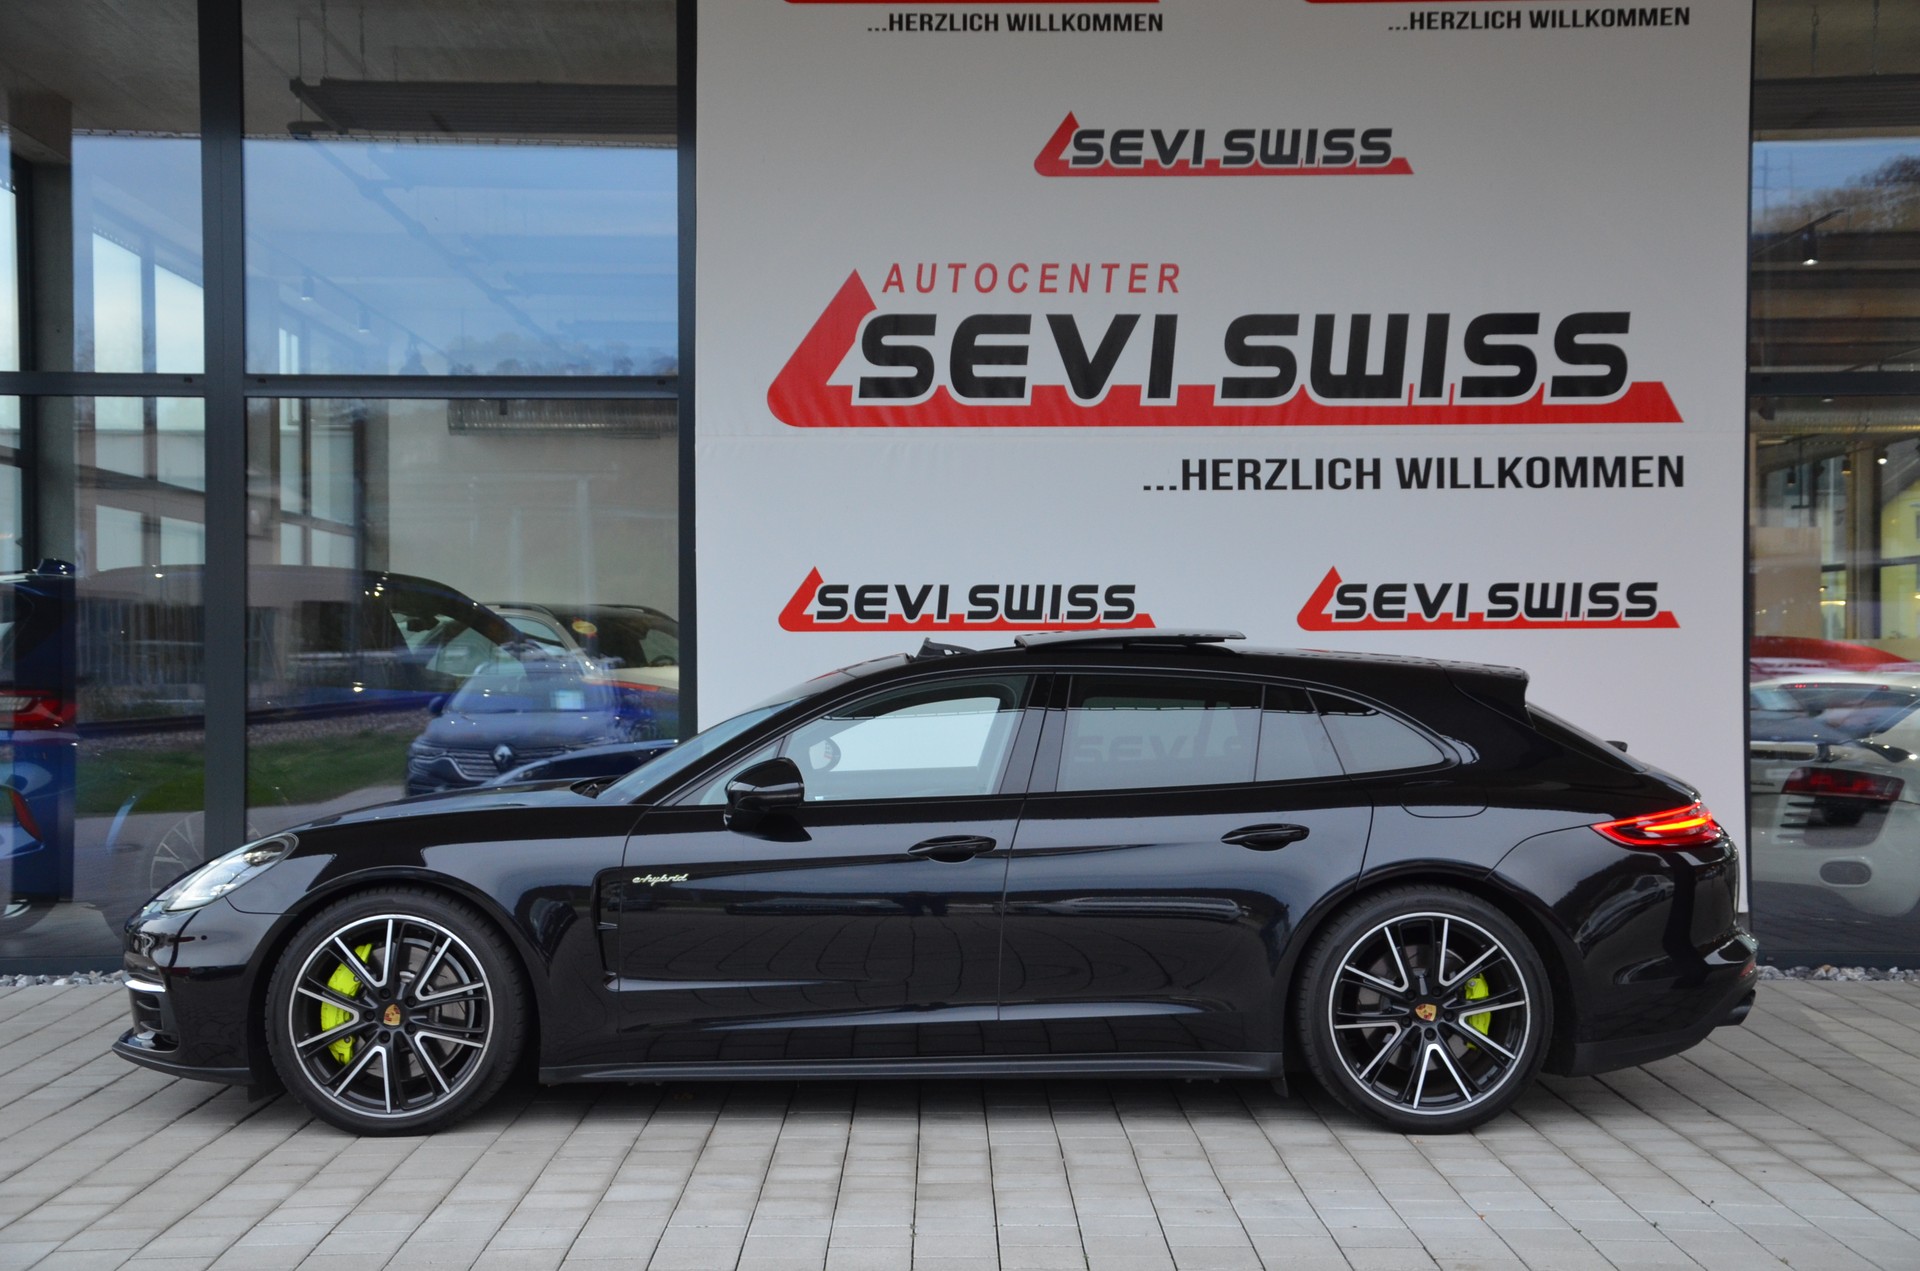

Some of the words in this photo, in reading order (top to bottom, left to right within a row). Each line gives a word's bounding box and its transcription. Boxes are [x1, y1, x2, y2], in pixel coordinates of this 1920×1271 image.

[868, 12, 998, 32] ...HERZLICH
[1006, 12, 1163, 32] WILLKOMMEN
[1388, 9, 1522, 31] ...HERZLICH
[1528, 6, 1691, 30] WILLKOMMEN
[1072, 128, 1206, 167] SEVI
[1222, 127, 1394, 166] SWISS
[882, 263, 1180, 294] AUTOCENTER
[857, 312, 1179, 401] SEVI
[1219, 310, 1632, 400] SWISS
[1142, 457, 1381, 492] ...HERZLICH
[1396, 454, 1684, 490] WILLKOMMEN
[815, 584, 950, 620] SEVI
[966, 583, 1137, 620] SWISS
[1334, 582, 1470, 619] SEVI
[1485, 581, 1659, 618] SWISS
